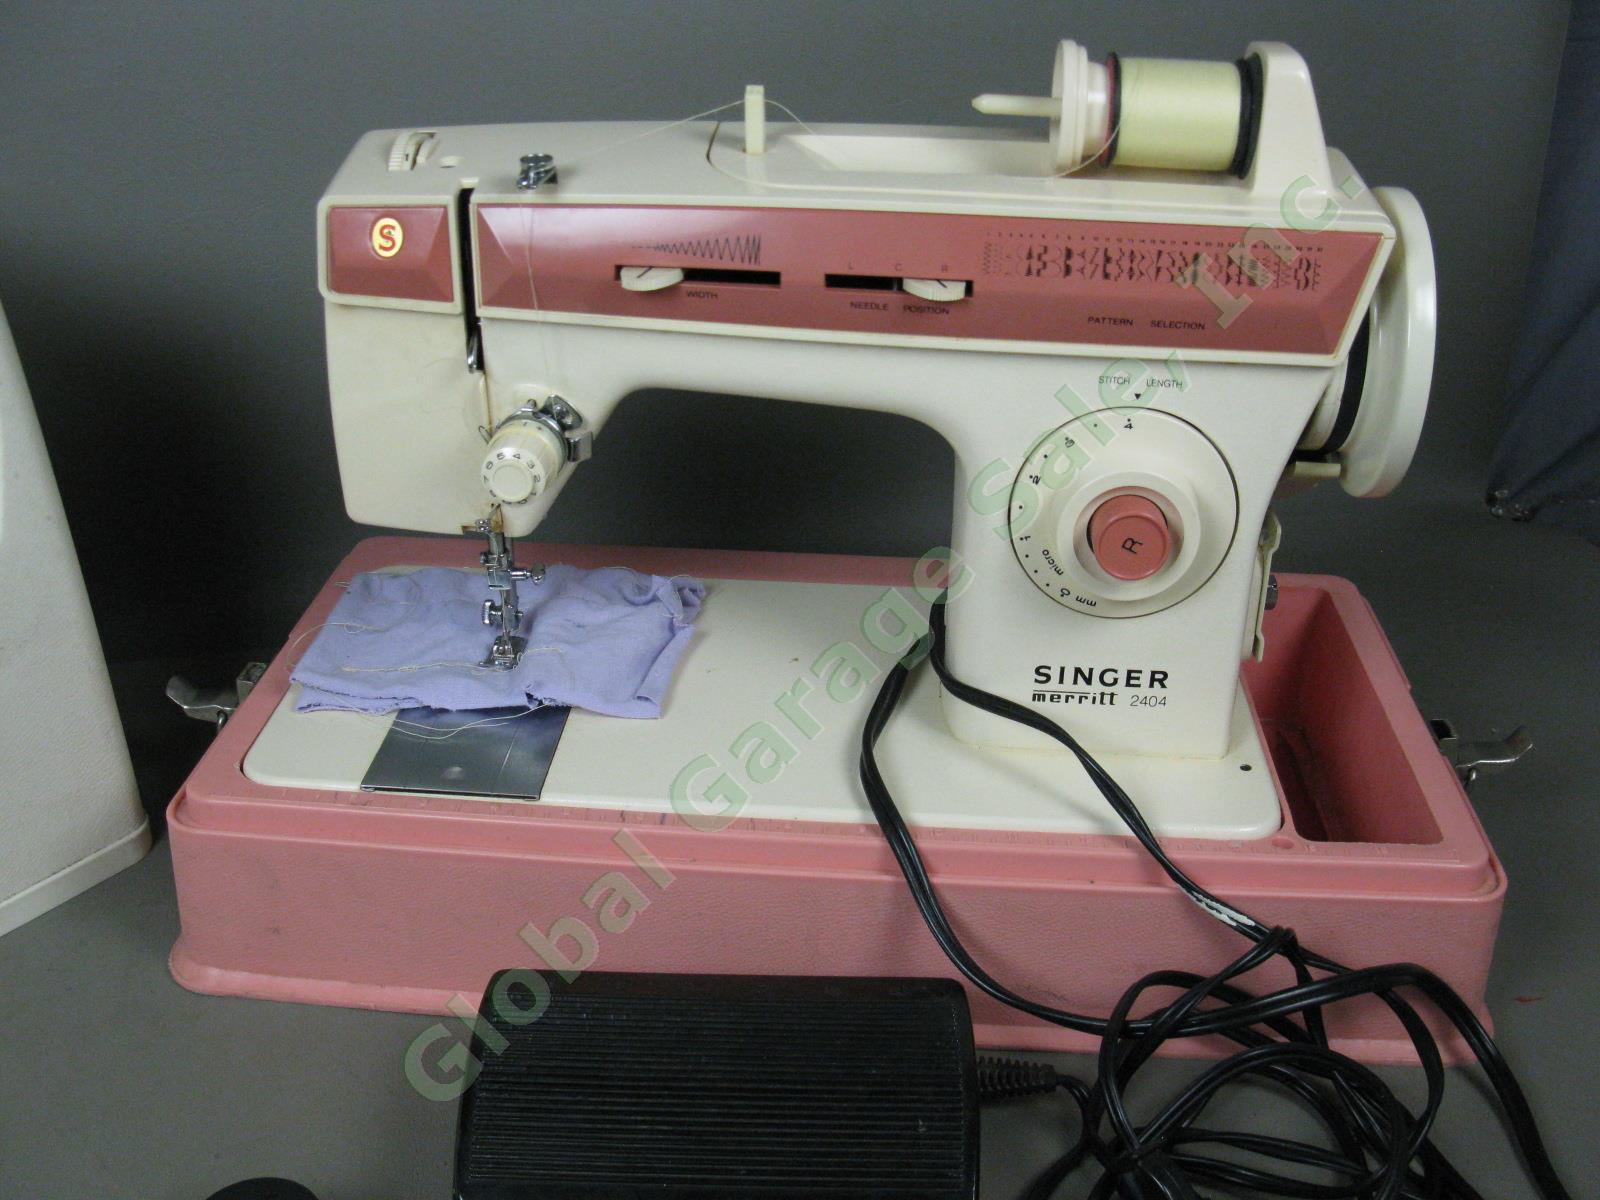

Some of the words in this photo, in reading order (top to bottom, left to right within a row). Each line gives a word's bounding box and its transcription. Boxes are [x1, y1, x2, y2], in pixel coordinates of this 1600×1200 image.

[377, 222, 398, 253] S
[686, 290, 719, 300] WIDTH
[850, 301, 889, 312] NEEDLE
[903, 304, 951, 315] POSITION
[1087, 315, 1134, 327] PATTERN
[1150, 319, 1206, 331] SELECTION
[1098, 375, 1131, 385] STITCH
[1146, 378, 1183, 389] LENGTH
[1123, 421, 1134, 431] 4
[1031, 474, 1041, 486] 2
[1121, 536, 1144, 555] R
[1041, 548, 1065, 577] micro
[1075, 594, 1097, 608] mm
[1034, 665, 1169, 689] SINGER
[1031, 691, 1119, 706] merritt
[1129, 694, 1168, 708] 2404
